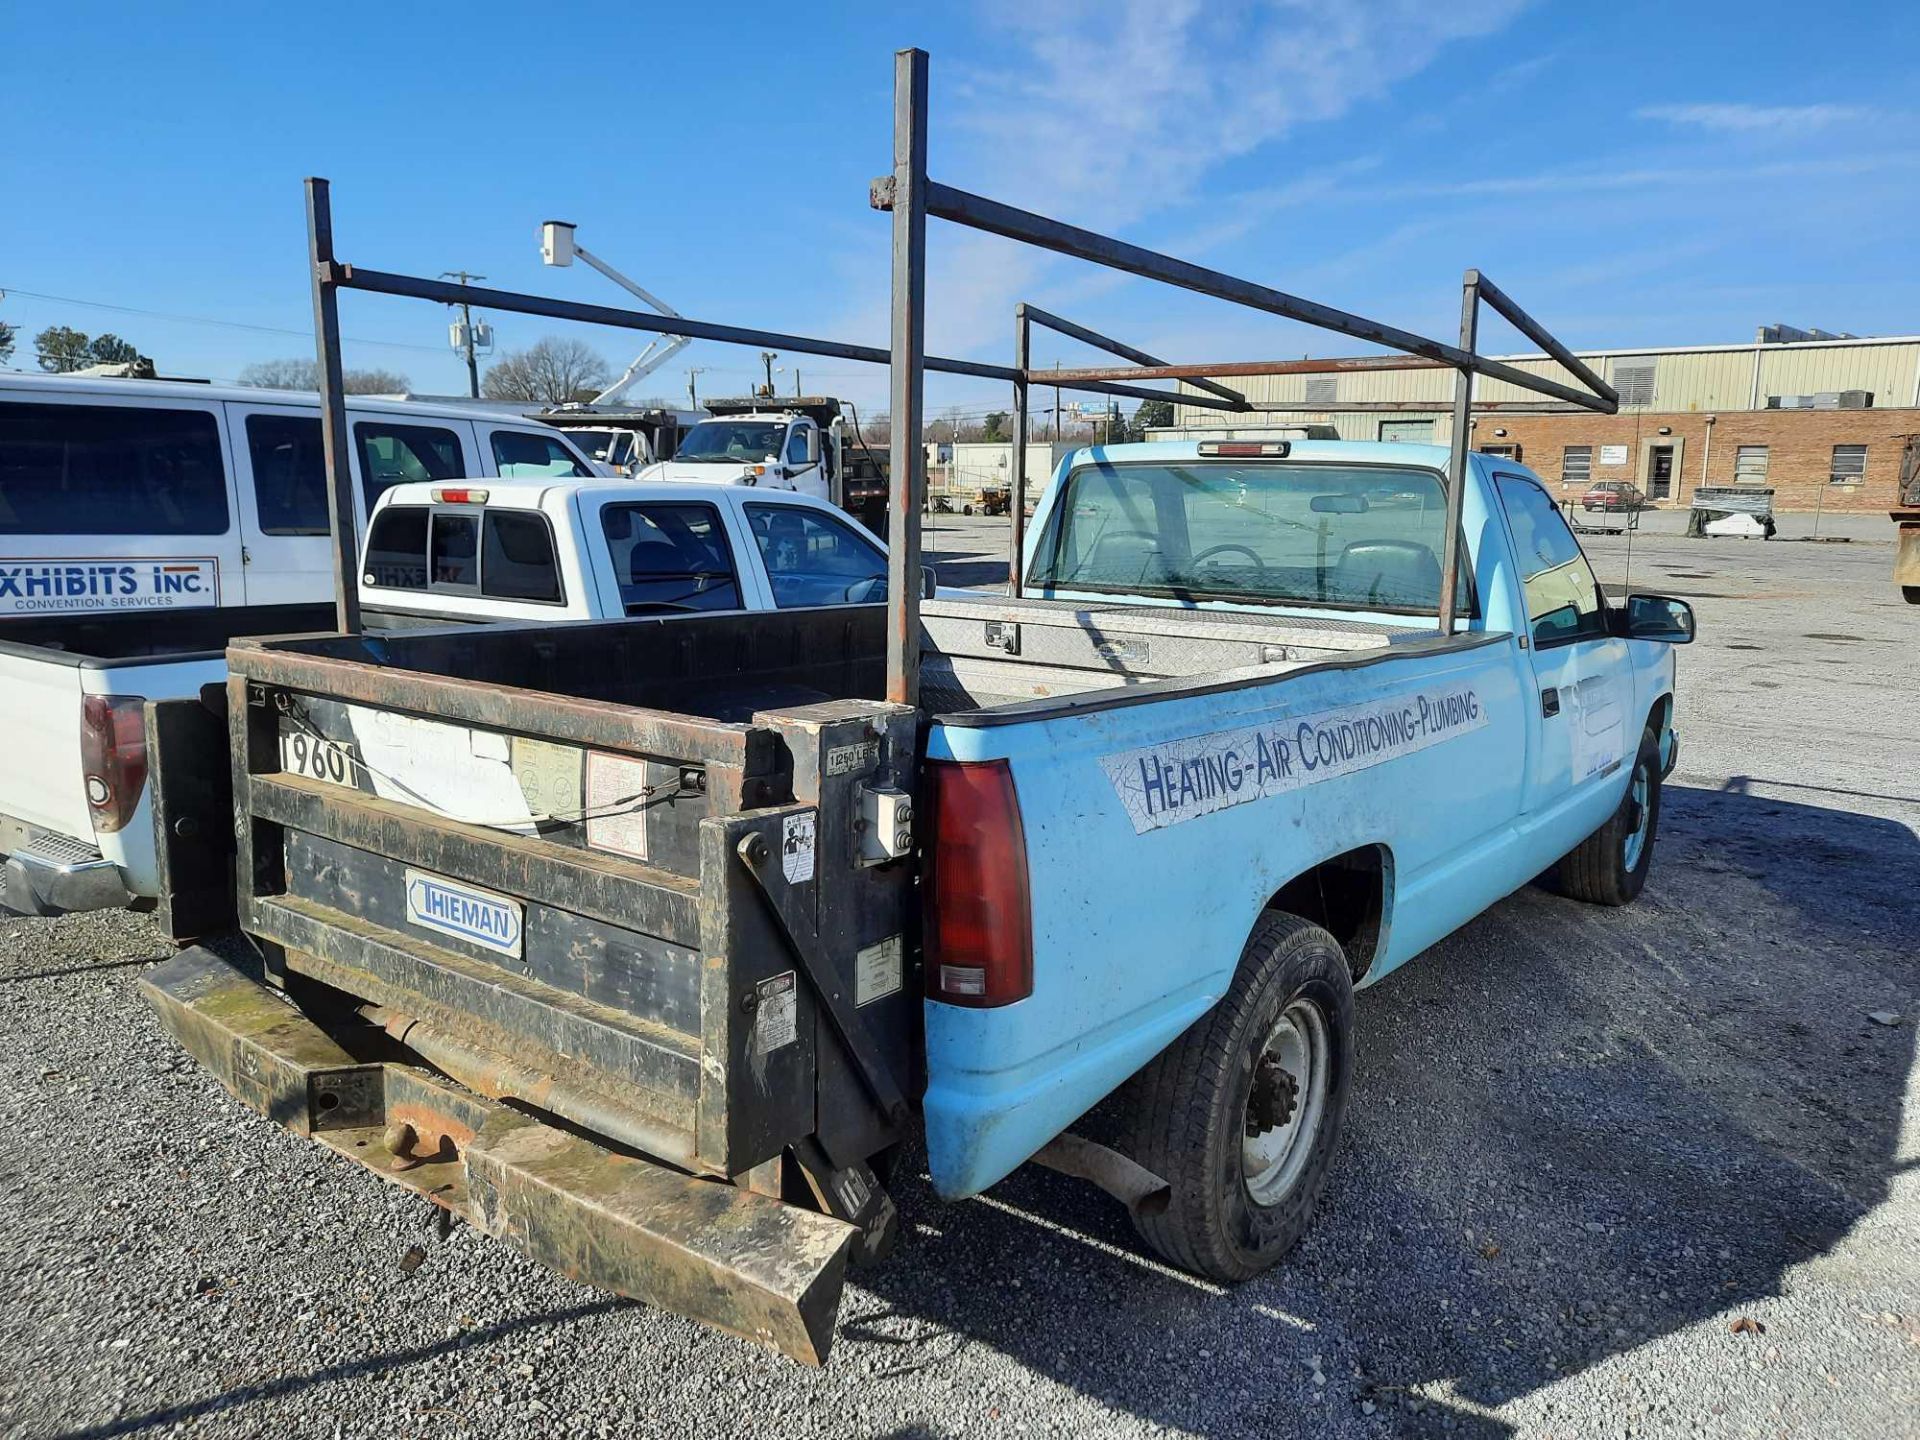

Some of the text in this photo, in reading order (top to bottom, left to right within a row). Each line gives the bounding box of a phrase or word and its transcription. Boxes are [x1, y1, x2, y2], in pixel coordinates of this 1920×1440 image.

[15, 596, 174, 610] CONVENTION SERVICES
[419, 880, 509, 939] THIEMAN
